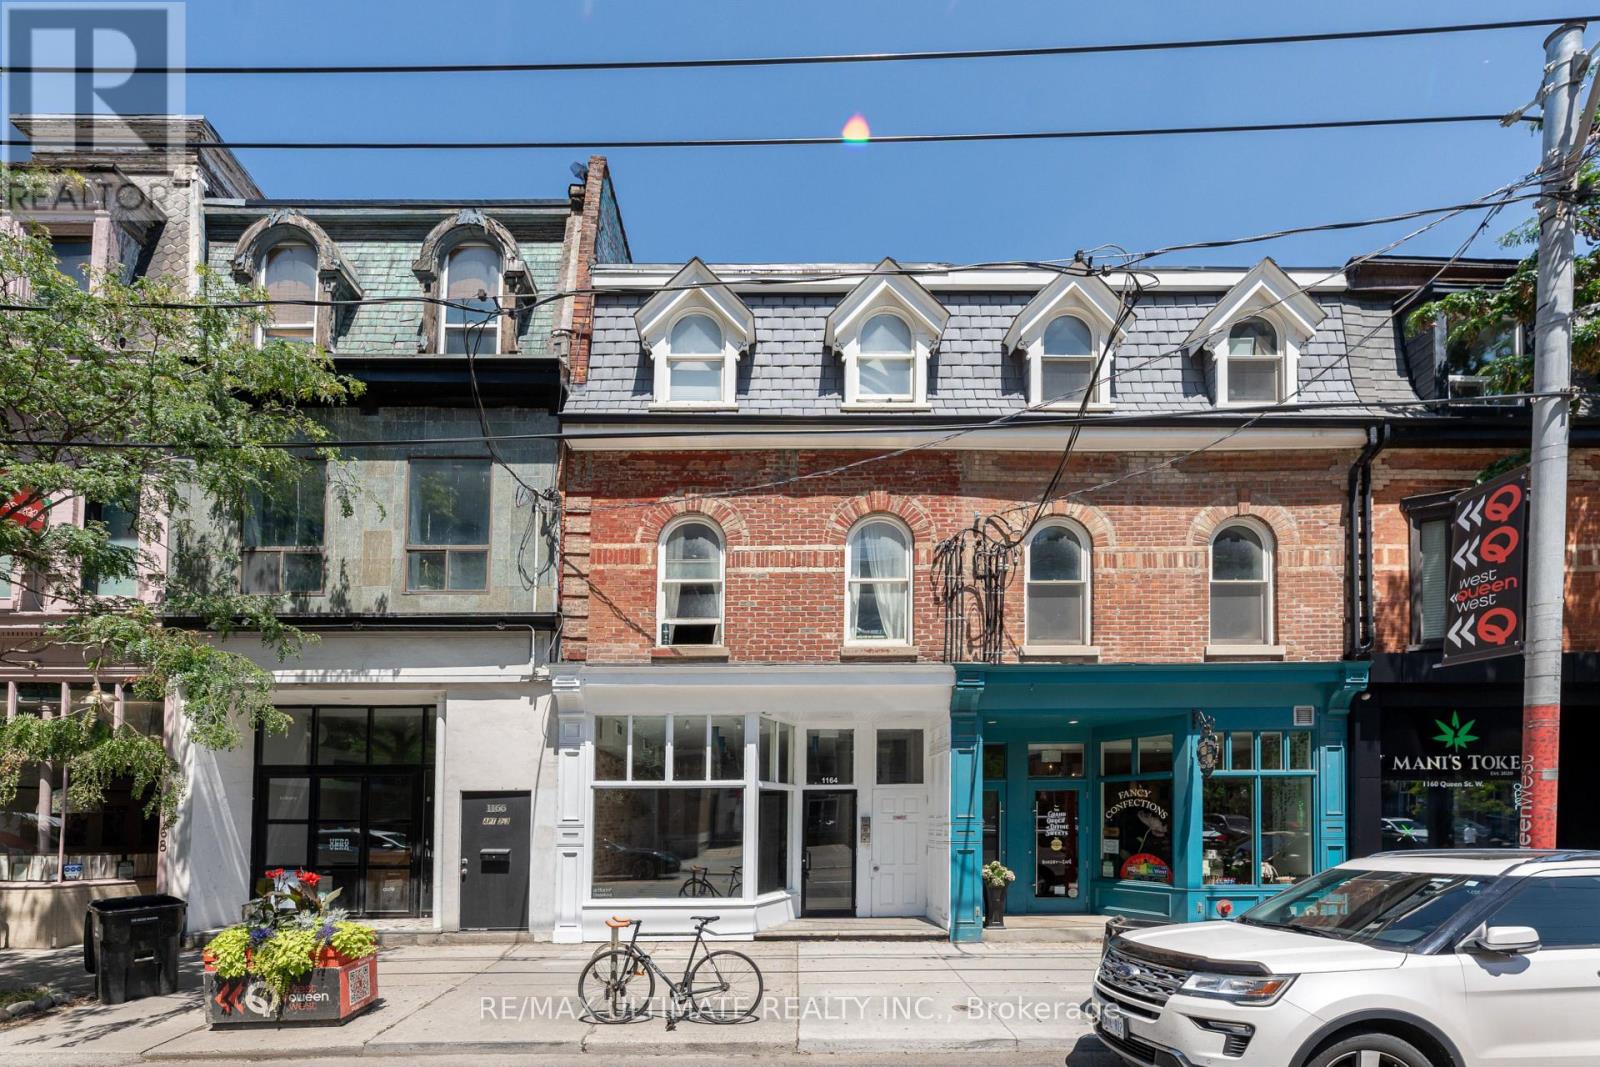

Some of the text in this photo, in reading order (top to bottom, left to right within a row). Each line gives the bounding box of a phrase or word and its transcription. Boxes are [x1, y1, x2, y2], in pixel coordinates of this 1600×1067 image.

[1484, 484, 1522, 522] Q
[1479, 525, 1519, 564] Q
[1459, 569, 1497, 588] west
[1456, 593, 1497, 613] west
[1476, 607, 1517, 645] Q
[1392, 754, 1462, 771] MANI'S
[820, 776, 838, 784] 1164
[1440, 781, 1463, 789] Queen
[1118, 788, 1152, 800] FANCY
[1105, 799, 1169, 820] CONFECTIONS
